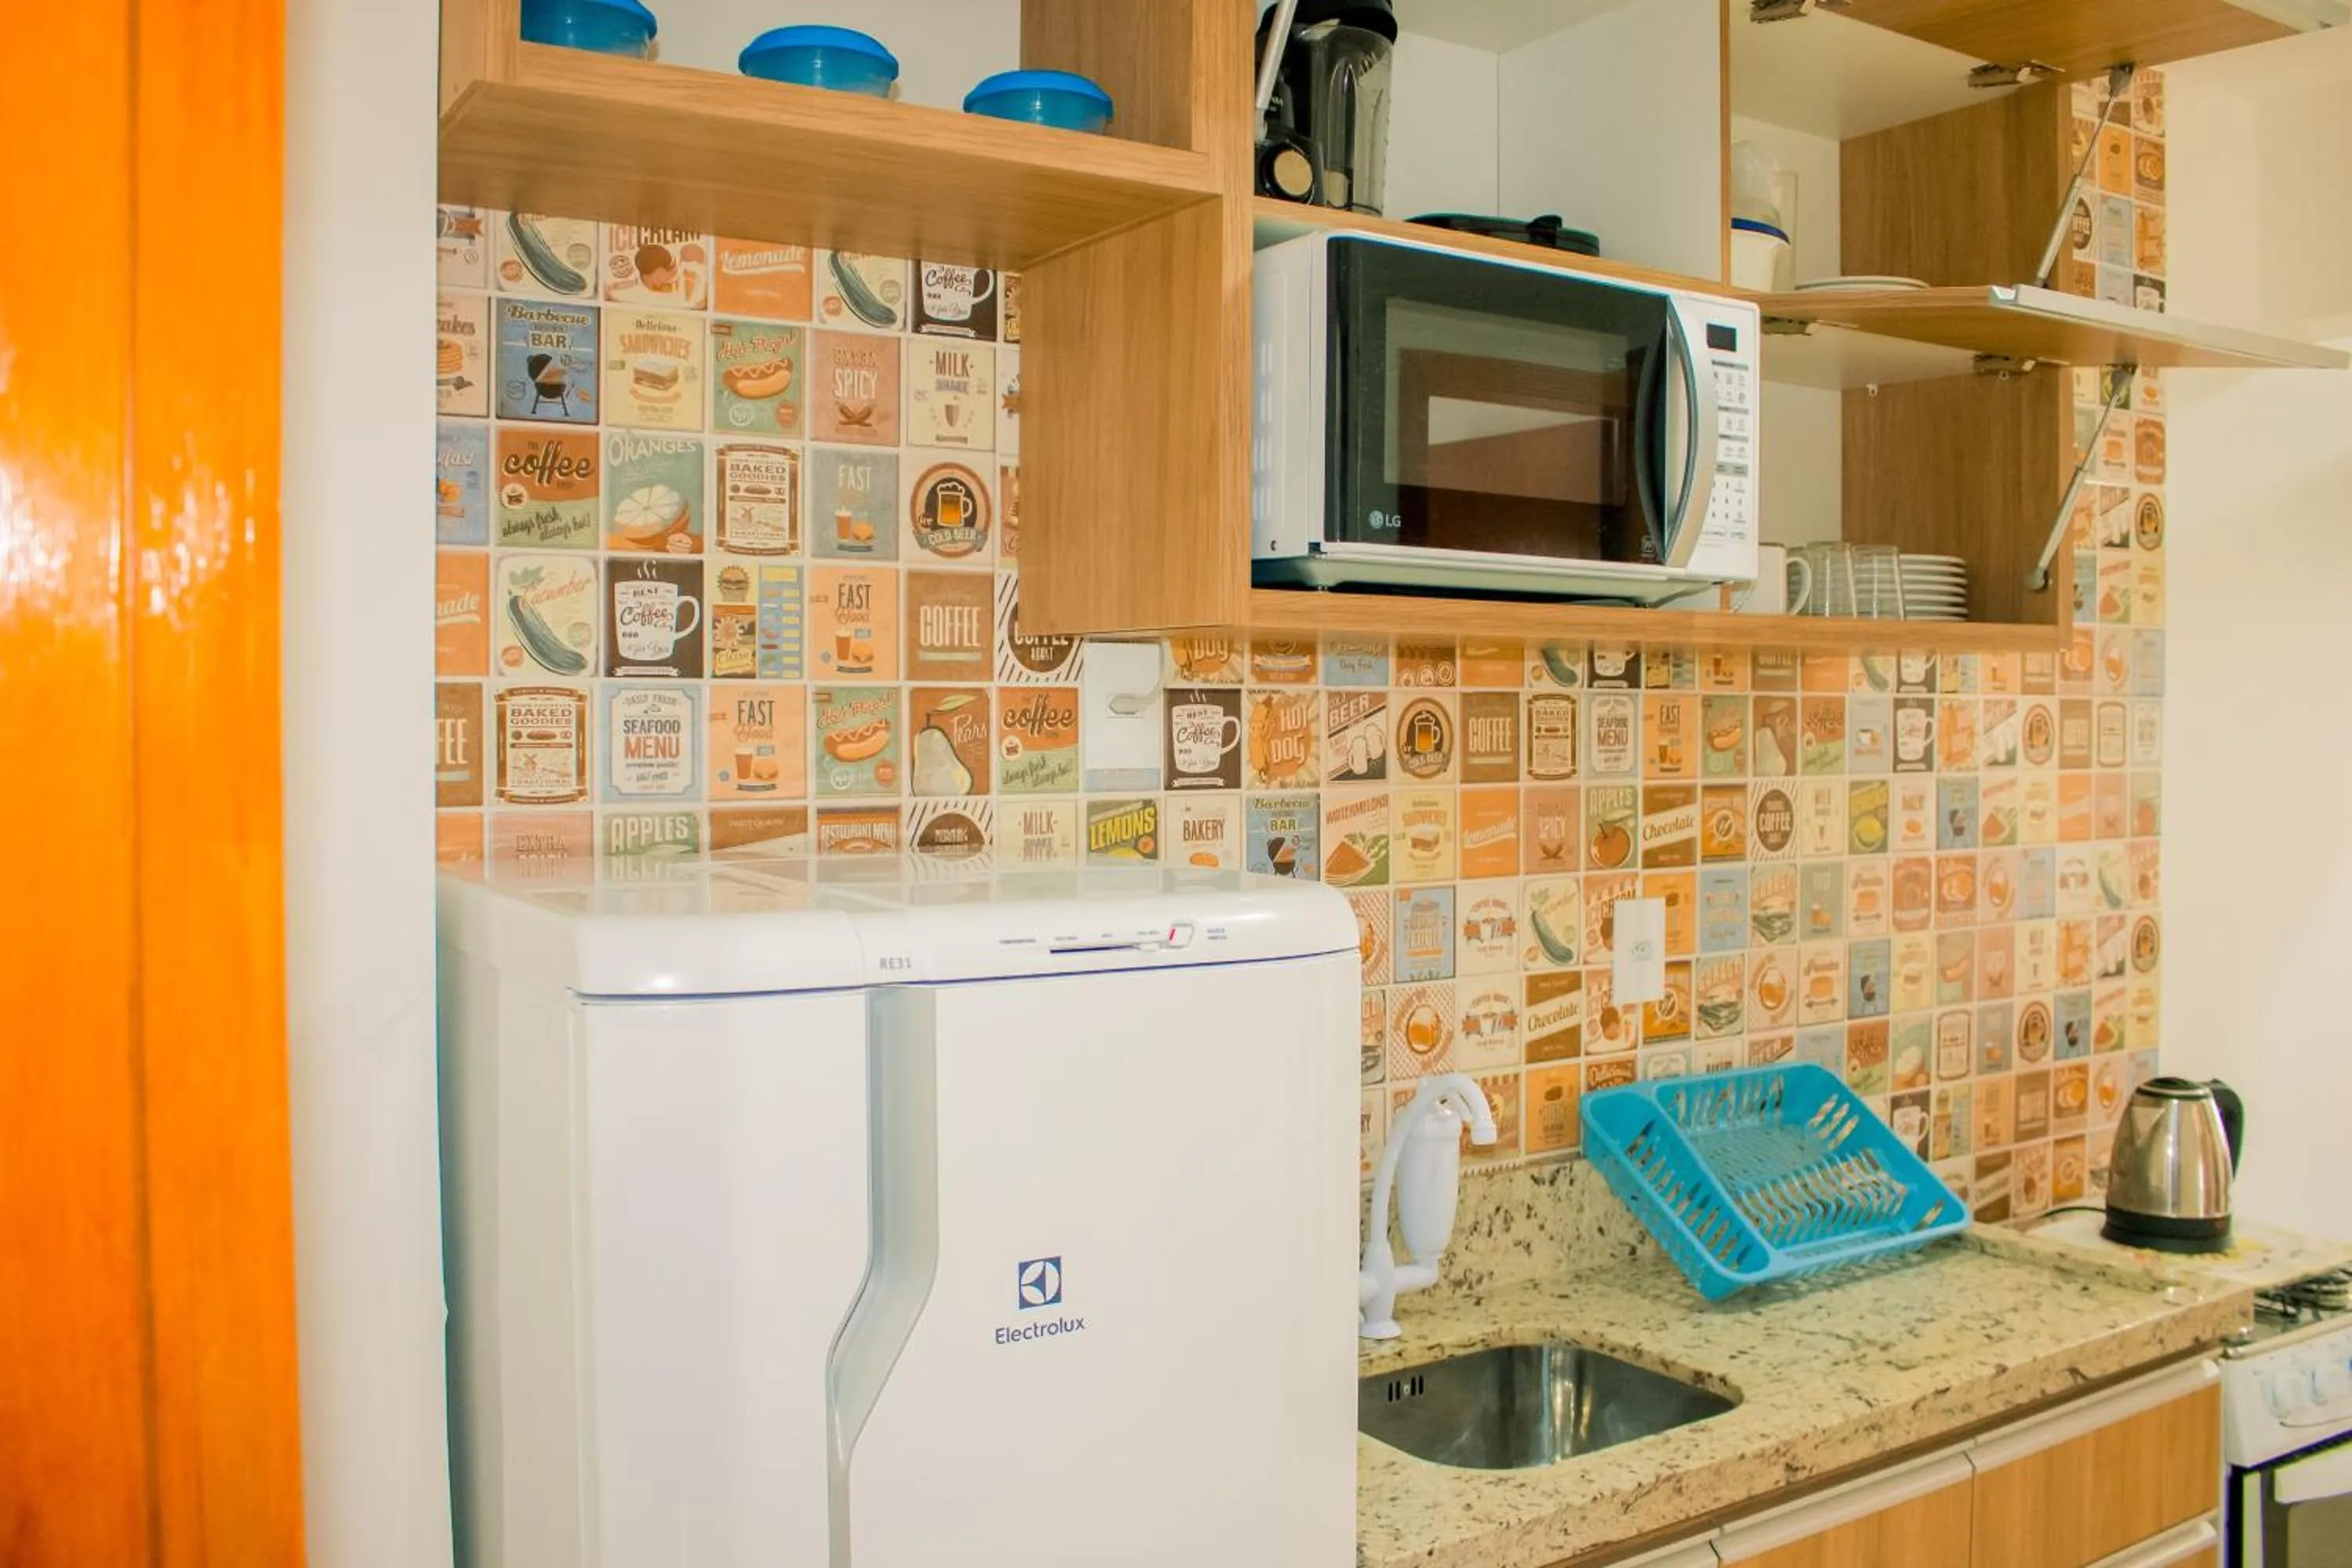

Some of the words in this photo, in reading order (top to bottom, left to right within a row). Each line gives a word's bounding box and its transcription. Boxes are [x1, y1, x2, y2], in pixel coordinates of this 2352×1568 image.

[508, 305, 590, 326] Barbecue
[635, 319, 677, 333] Delicious
[531, 332, 567, 348] BAR
[619, 334, 693, 360] SANDWICHES
[935, 351, 970, 378] MILK
[833, 368, 879, 401] SPICY
[502, 439, 594, 486] coffee
[608, 439, 698, 467] ORANGES
[730, 463, 786, 474] BAKED
[838, 464, 873, 492] FAST
[1385, 514, 1401, 528] LG
[837, 583, 873, 609] FAST
[920, 604, 982, 648] COFFEE
[510, 707, 573, 718] BAKED
[737, 700, 775, 727] FAST
[1002, 693, 1077, 737] coffee
[1280, 704, 1309, 733] HOT
[1329, 693, 1370, 728] BEER
[622, 719, 681, 735] SEAFOOD
[1468, 717, 1512, 753] COFFEE
[1597, 728, 1629, 746] MENU
[624, 735, 681, 760] MENU
[1270, 735, 1306, 765] DOG
[1588, 788, 1634, 816] APPLES
[611, 815, 689, 854] APPLES
[1022, 811, 1054, 837] MILK
[1090, 806, 1155, 851] LEMONS
[1182, 818, 1225, 842] BAKERY
[1269, 818, 1296, 832] BAR
[1642, 815, 1696, 842] Chocolate
[879, 956, 912, 971] RE31
[995, 1316, 1085, 1345] Electrolux
